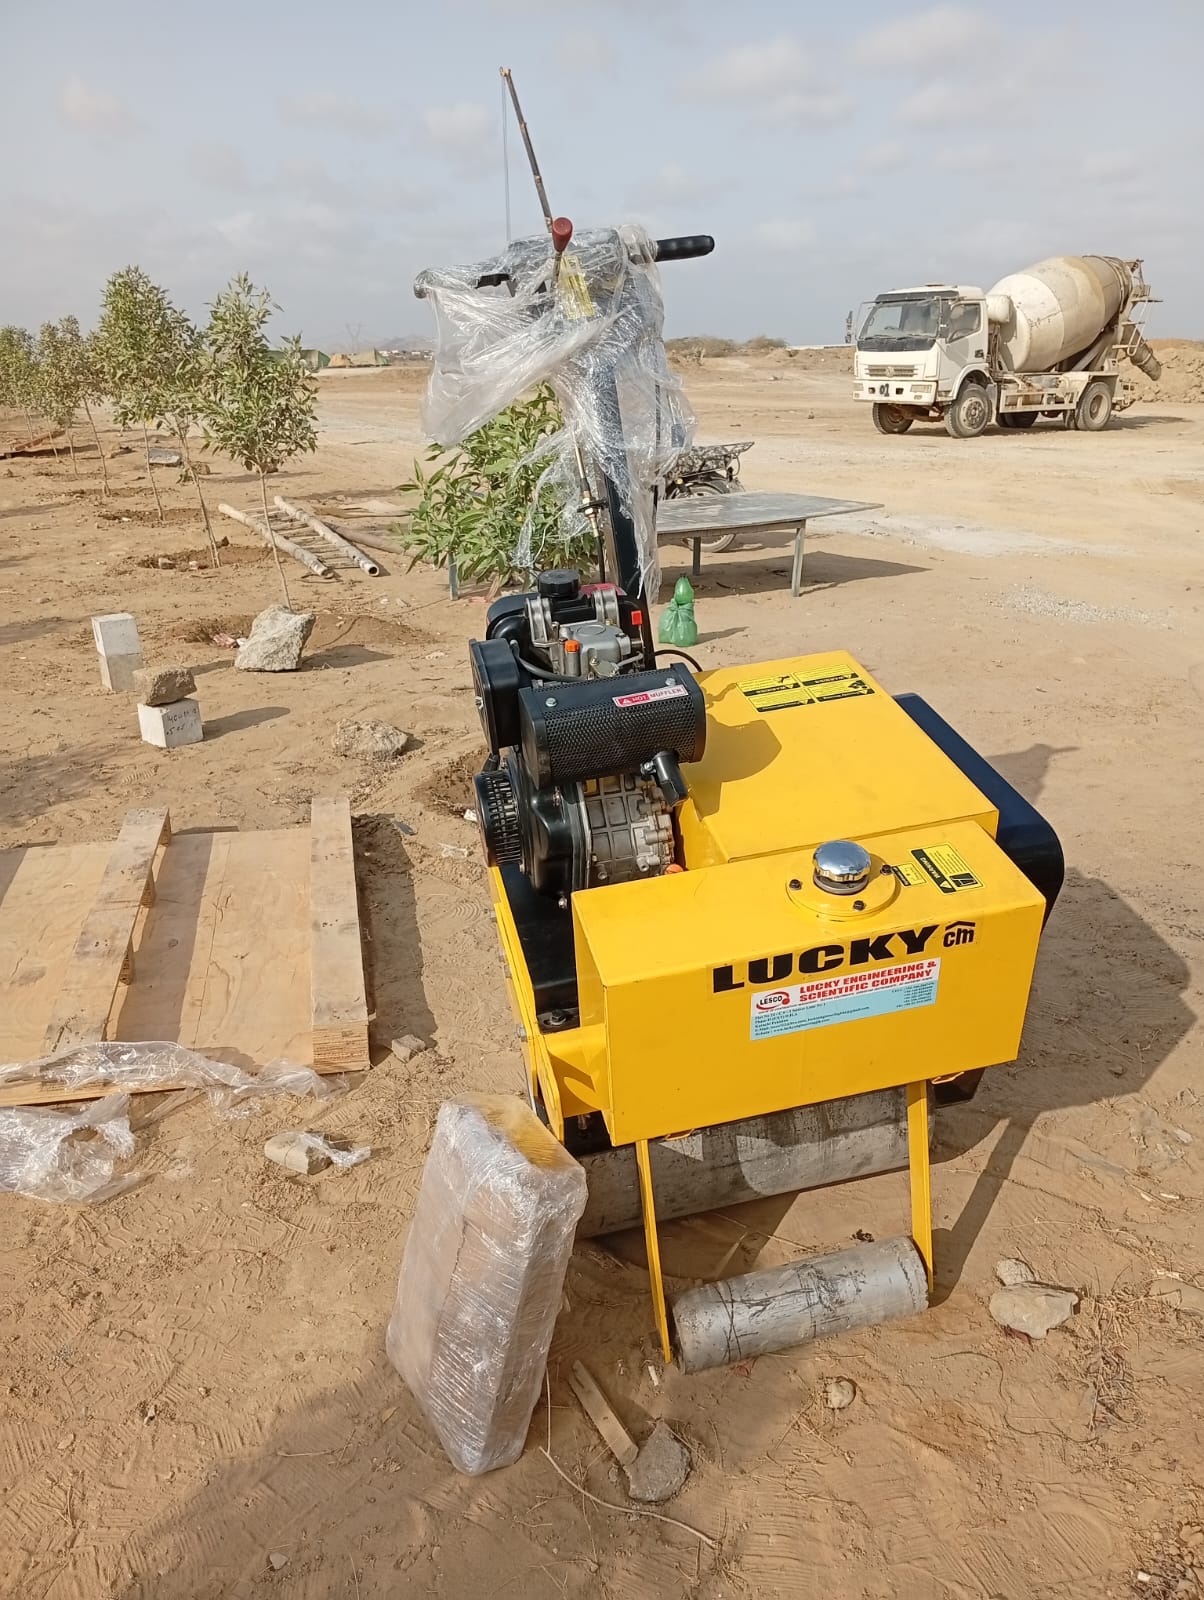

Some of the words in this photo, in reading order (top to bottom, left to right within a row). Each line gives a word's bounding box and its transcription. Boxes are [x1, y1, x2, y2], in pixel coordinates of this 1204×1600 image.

[650, 688, 683, 698] MUFFLER
[713, 924, 940, 993] LUCKY
[800, 979, 840, 993] LUCKY
[843, 962, 924, 985] ENGINEERING
[800, 982, 868, 1002] SCIENTIFIC
[872, 969, 932, 988] COMPANY
[760, 995, 783, 1005] LESCO
